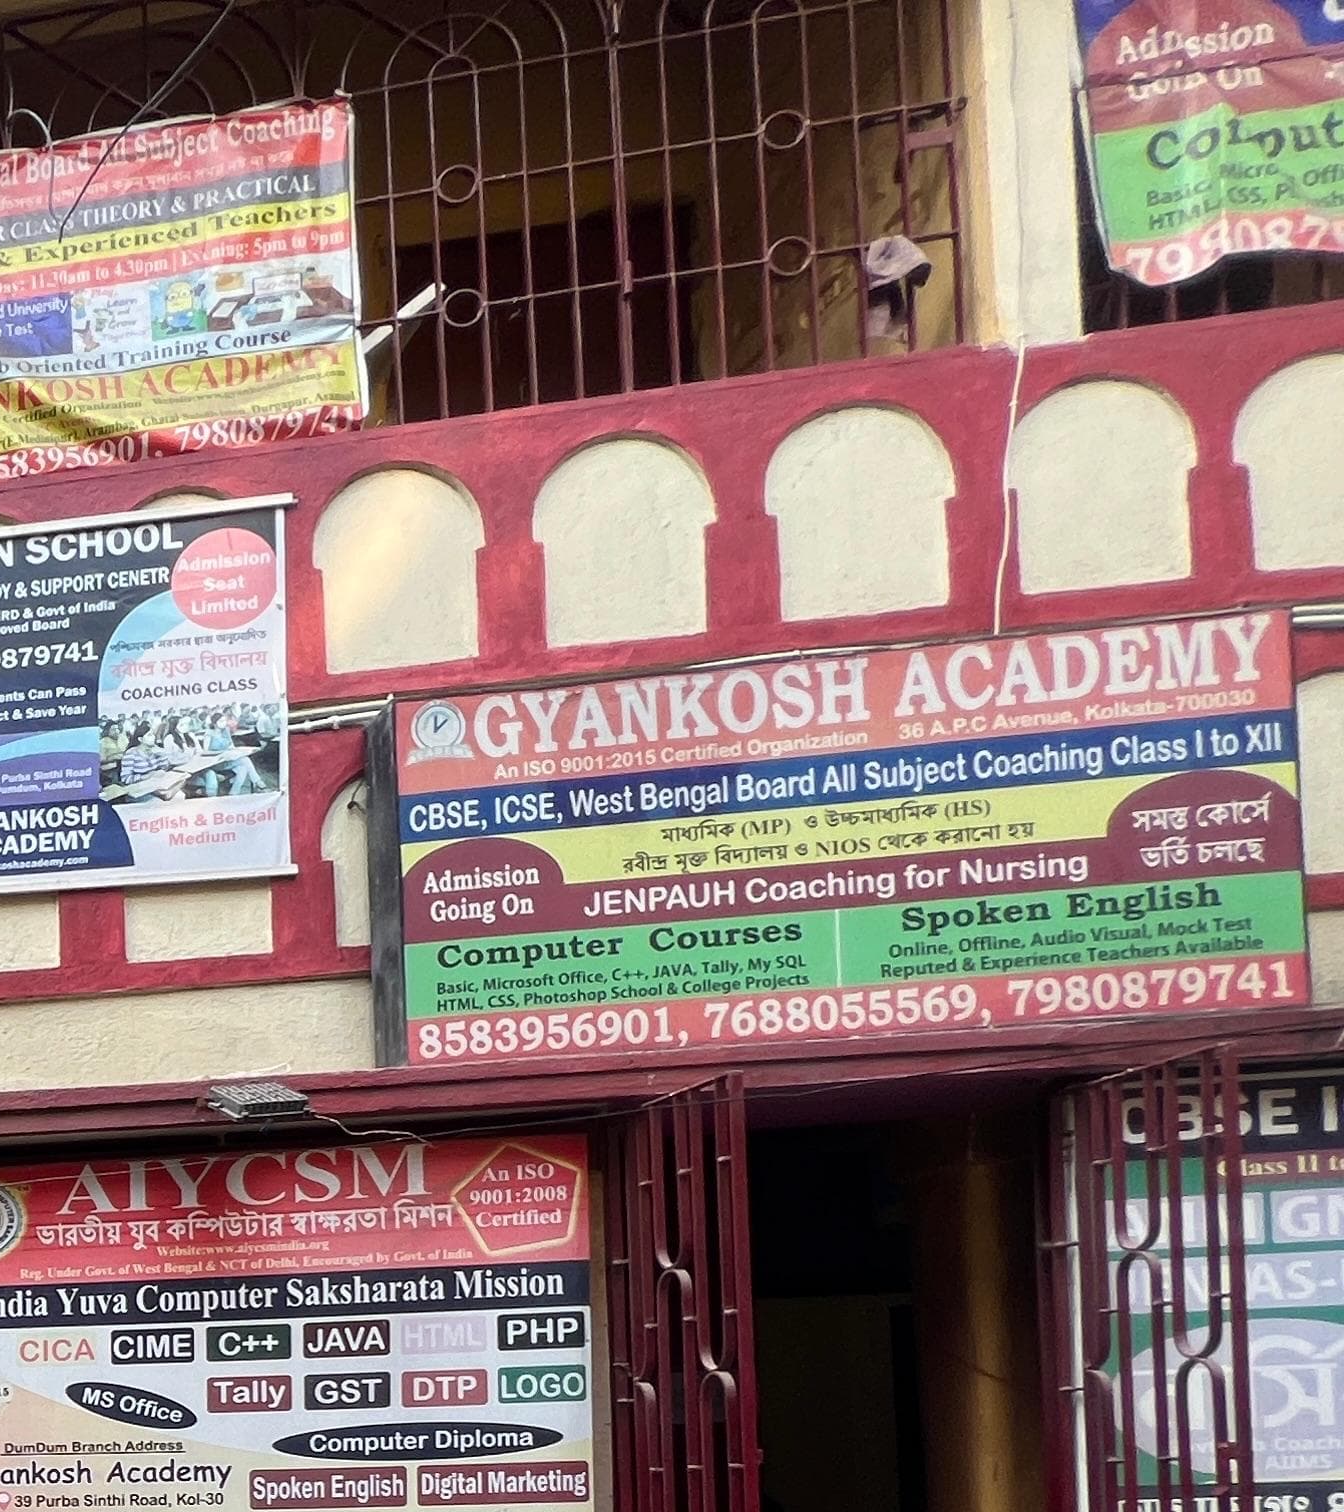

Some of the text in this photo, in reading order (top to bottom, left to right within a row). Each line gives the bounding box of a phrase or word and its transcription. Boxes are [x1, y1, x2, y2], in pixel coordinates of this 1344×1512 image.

[79, 197, 165, 227] THEORY
[194, 174, 316, 209] PRACTICAL
[25, 202, 337, 263] Experienced Teachers
[117, 339, 209, 367] Training
[215, 328, 291, 350] Course
[25, 524, 183, 565] SCHOOL
[14, 582, 28, 598] &
[30, 574, 104, 596] SUPPORT
[107, 567, 170, 589] CENETR
[121, 678, 258, 701] COACHING CLASS
[474, 614, 1271, 758] GYANKOSH ACADEMY
[494, 731, 868, 780] An ISO 9001:2015 Certified Organization
[409, 722, 1281, 832] CBSE, ICSE, West Bengal Board All Subject Coaching Class I to XII
[1131, 792, 1272, 832] সমস্ত কোর্সে
[1139, 836, 1265, 868] ভর্তি চলছে
[423, 864, 539, 895] Admission
[583, 853, 1089, 917] JENPAUH Coaching for Nursing
[430, 894, 534, 924] Going On
[901, 882, 1222, 937] Spoken English
[437, 923, 802, 969] Computer Courses
[437, 954, 807, 996] Basic, Microsoft Office, C++, JAVA, Tally, My SQL
[418, 961, 1294, 1059] 8583956901, 7688055569, 7980879741
[56, 1143, 432, 1215] AIYCSM
[481, 1162, 556, 1182] An ISO
[469, 1186, 567, 1205] 9001:2008
[36, 1215, 123, 1247] ভারতীয়
[128, 1220, 161, 1250] যুব
[167, 1209, 283, 1240] কম্পিউটার
[392, 1199, 454, 1229] মিশন
[475, 1208, 562, 1229] Certified
[56, 1288, 128, 1316] Yuva
[135, 1282, 279, 1318] Computer
[286, 1271, 446, 1308] Saksharata
[454, 1267, 564, 1300] Mission
[19, 1318, 579, 1363] CICA CIME C++ JAVA HTML PHP
[82, 1388, 184, 1423] MS Office
[213, 1372, 584, 1409] Tally GST DTP LOGO
[3, 1440, 184, 1454] DumDum Branch Address
[309, 1429, 534, 1455] Computer Diploma
[107, 1458, 233, 1488] Academy
[252, 1474, 405, 1503] Spoken English
[421, 1468, 587, 1498] Digital Marketing
[14, 1492, 224, 1508] 39 Purba Sinthi Road, Kol-30
